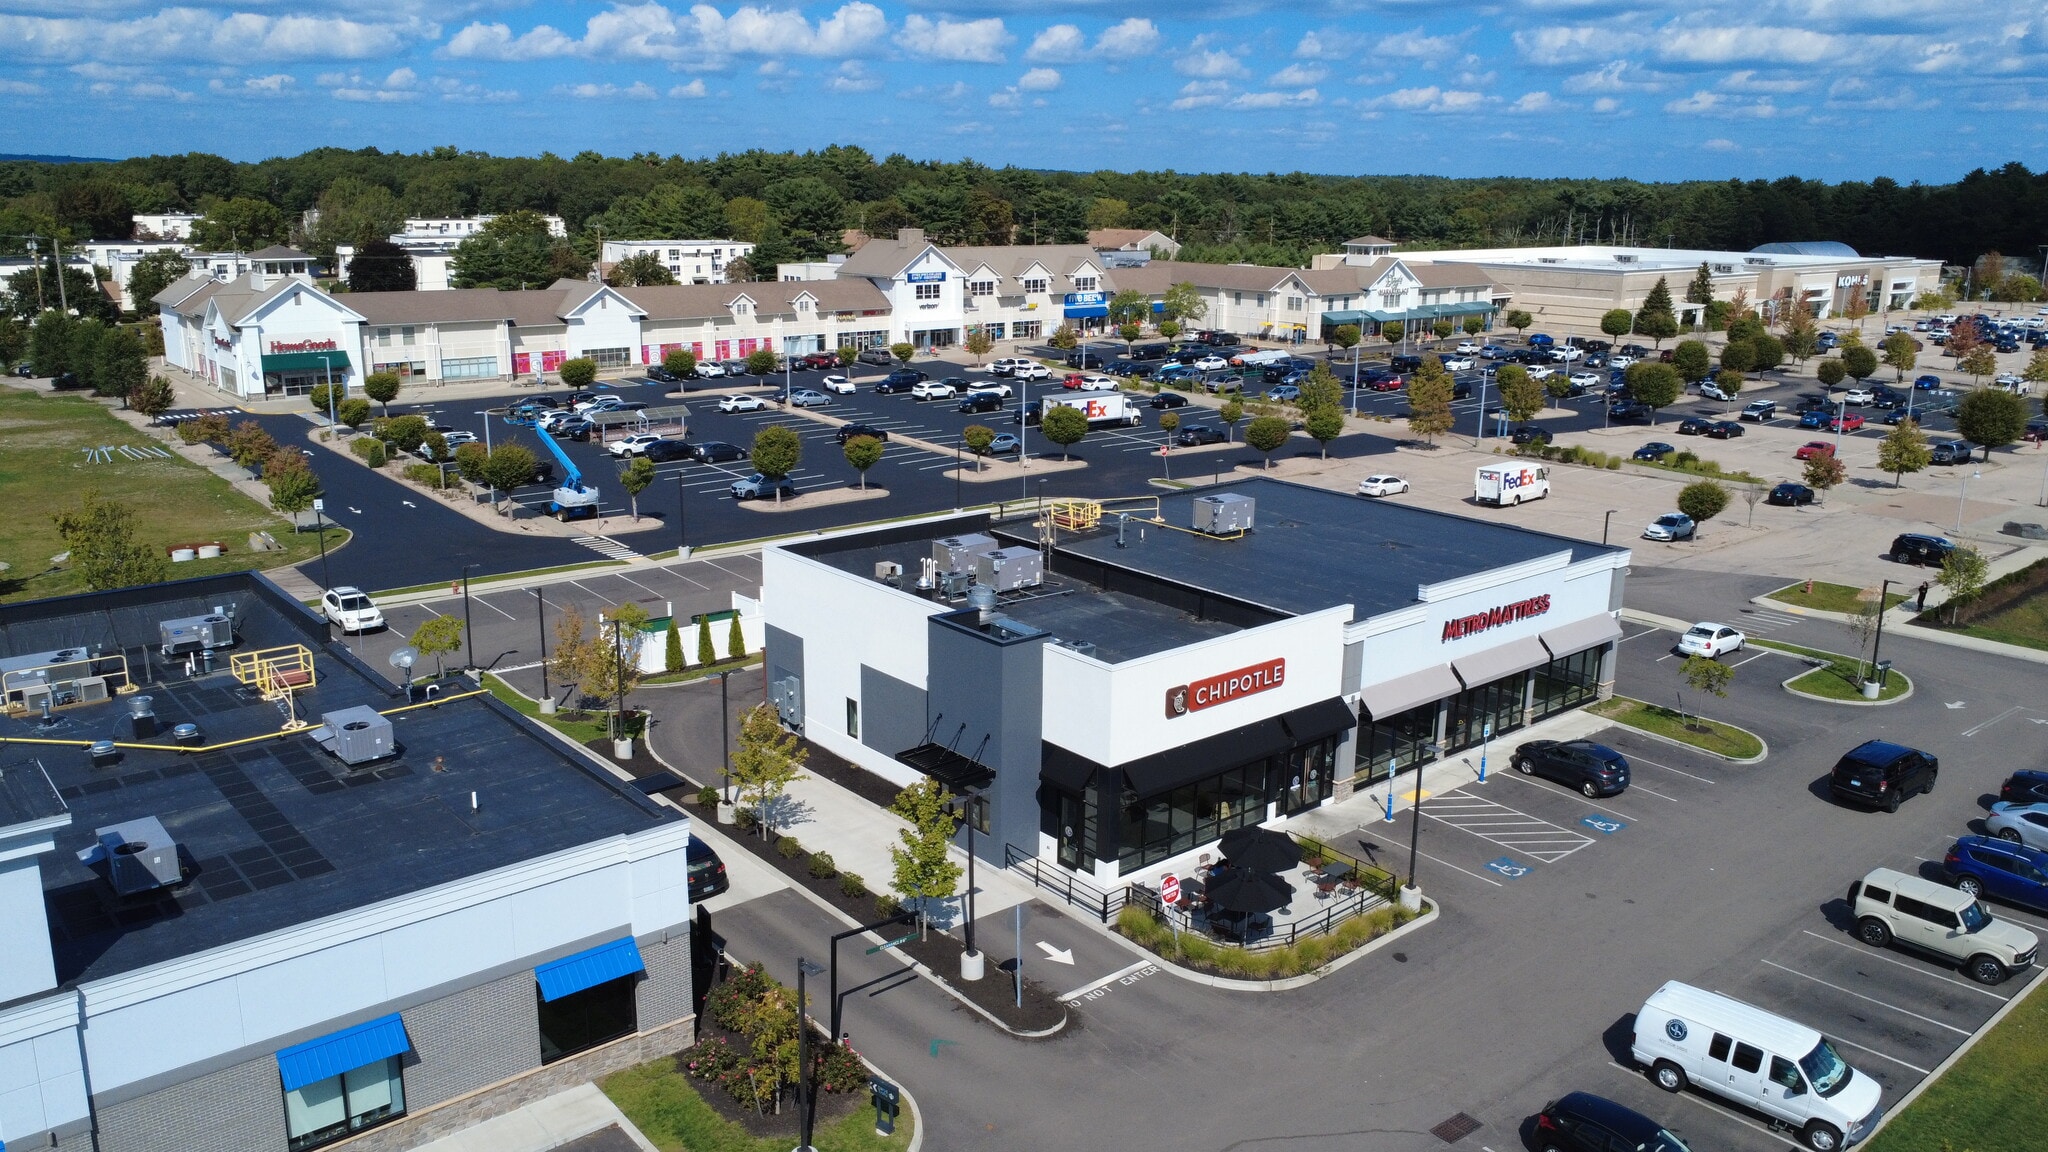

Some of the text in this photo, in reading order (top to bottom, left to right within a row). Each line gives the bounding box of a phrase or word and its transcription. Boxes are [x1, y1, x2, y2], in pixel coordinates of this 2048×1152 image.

[1838, 275, 1869, 287] KOHLS
[270, 338, 338, 352] HomeGoods
[1480, 472, 1499, 481] FedEx
[1503, 469, 1535, 491] FedEx
[1196, 665, 1283, 705] CHIPOTLE
[1083, 985, 1113, 1001] NOT
[1119, 965, 1161, 986] ENTER
